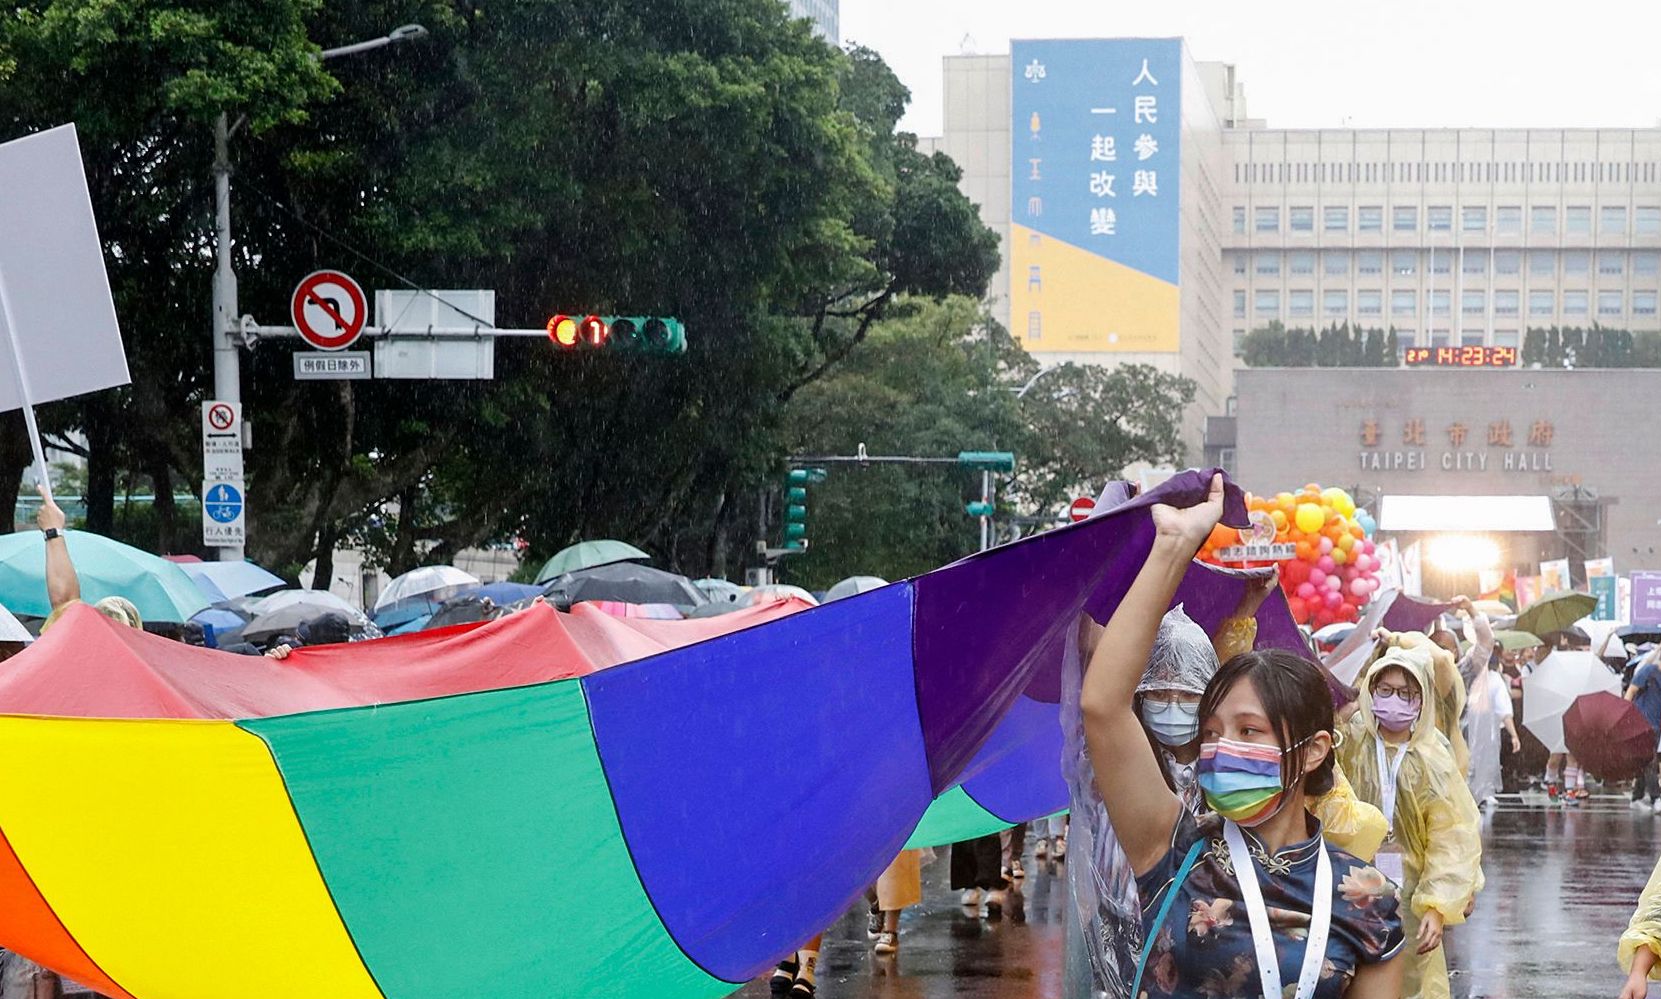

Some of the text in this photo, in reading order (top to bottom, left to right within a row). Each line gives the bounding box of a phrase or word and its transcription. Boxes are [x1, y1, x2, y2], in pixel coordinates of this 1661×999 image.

[1132, 58, 1159, 197] 人民參與
[1090, 107, 1117, 236] 一起改變
[1438, 347, 1514, 364] 14:23:24
[1361, 416, 1555, 447] 臺北市政府
[1360, 452, 1553, 470] TAIPEI CITY HALL
